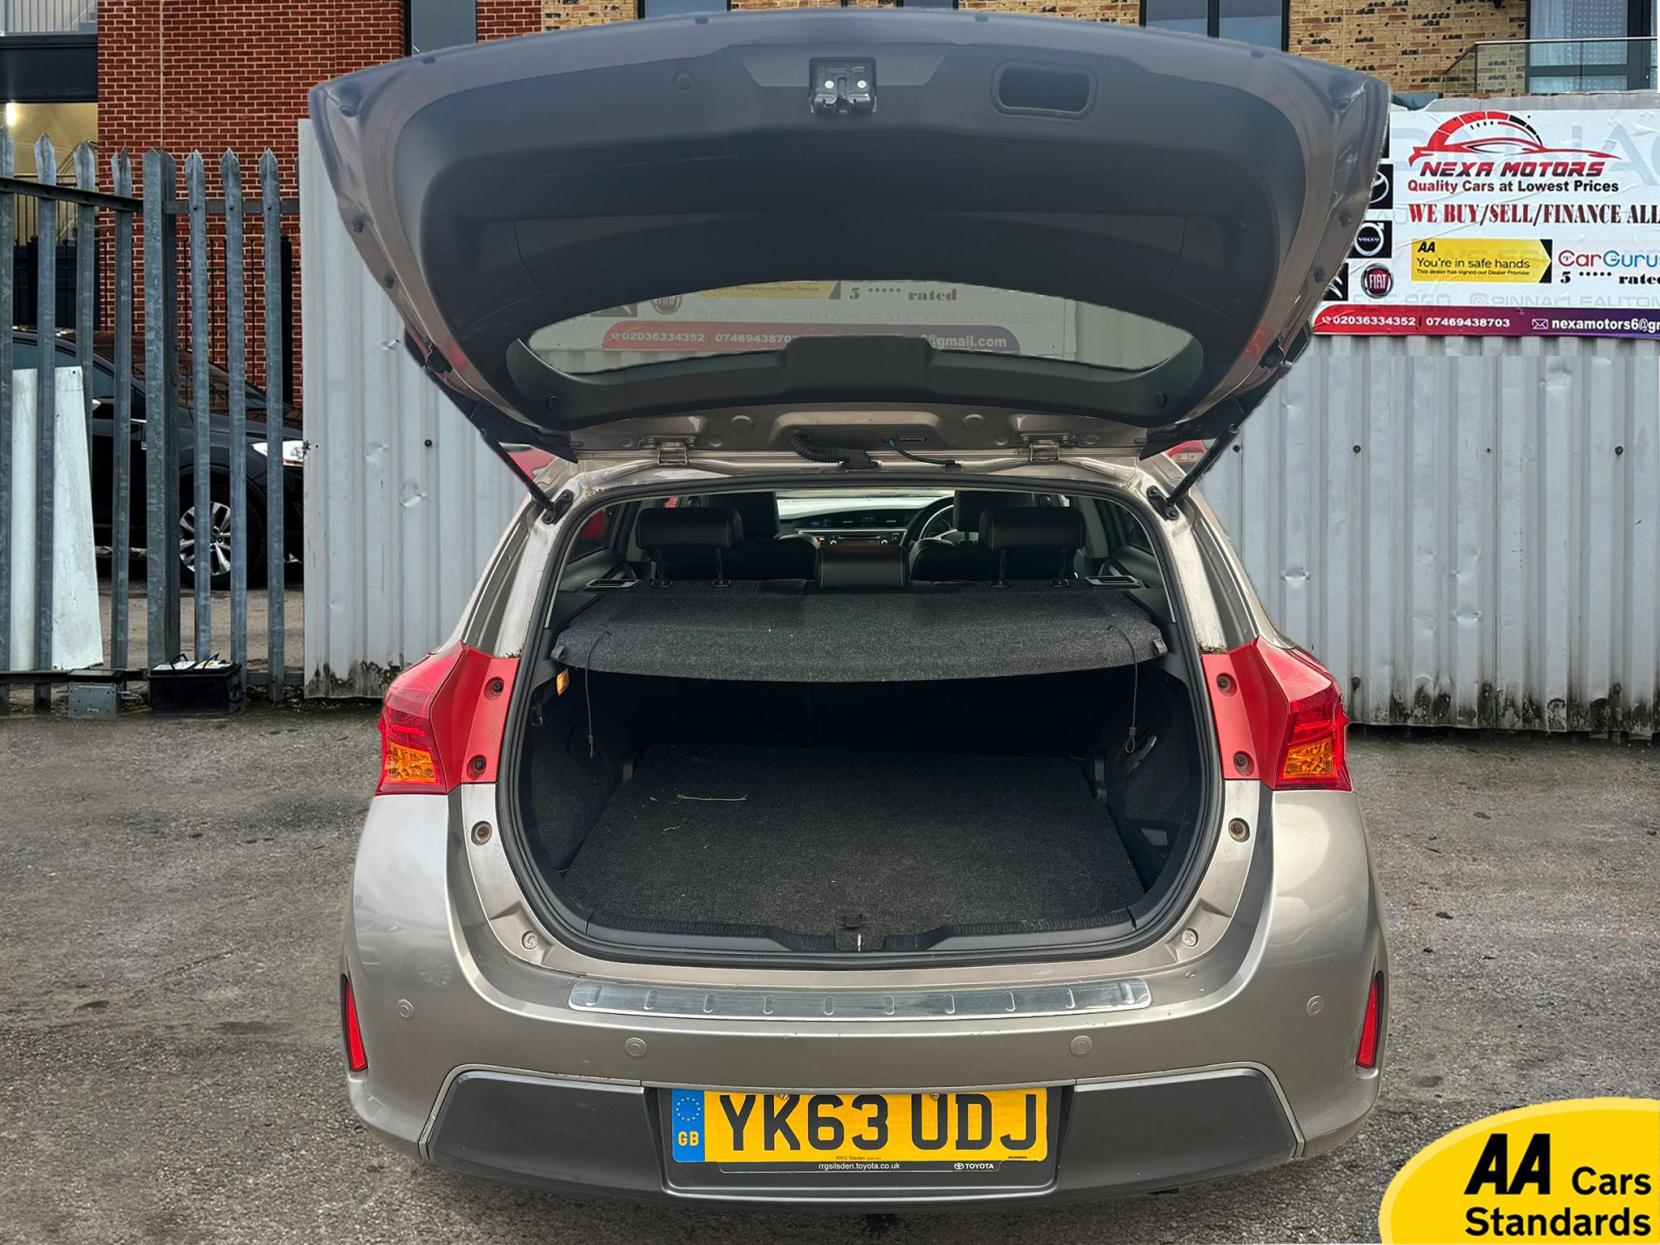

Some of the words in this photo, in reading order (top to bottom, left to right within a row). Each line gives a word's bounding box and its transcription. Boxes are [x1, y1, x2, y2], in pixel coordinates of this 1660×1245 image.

[1419, 161, 1495, 177] NEXA
[1500, 161, 1606, 178] MOTORS
[1407, 179, 1458, 193] Quality
[1462, 180, 1495, 192] Cars
[1500, 180, 1513, 192] at
[1518, 180, 1570, 192] Lowest
[1574, 180, 1619, 192] Prices
[1408, 203, 1438, 223] WE
[1626, 204, 1660, 224] ALL
[1417, 241, 1436, 253] AA
[1416, 257, 1452, 269] You're
[1454, 257, 1465, 268] in
[1468, 257, 1492, 269] safe
[1494, 258, 1531, 269] hands
[1558, 249, 1660, 268] CarGuru
[1369, 273, 1387, 289] FIAT
[1560, 271, 1571, 284] 5
[849, 287, 860, 300] 5
[908, 288, 957, 301] rated
[1332, 316, 1416, 326] 02036334352
[1425, 316, 1511, 328] 07469438703
[621, 332, 705, 342] 02036334352
[719, 1093, 889, 1151] YK63
[911, 1093, 1037, 1151] UDJ
[677, 1131, 700, 1147] GB
[818, 1162, 901, 1171] rrgsilsden.toyota.co.uk
